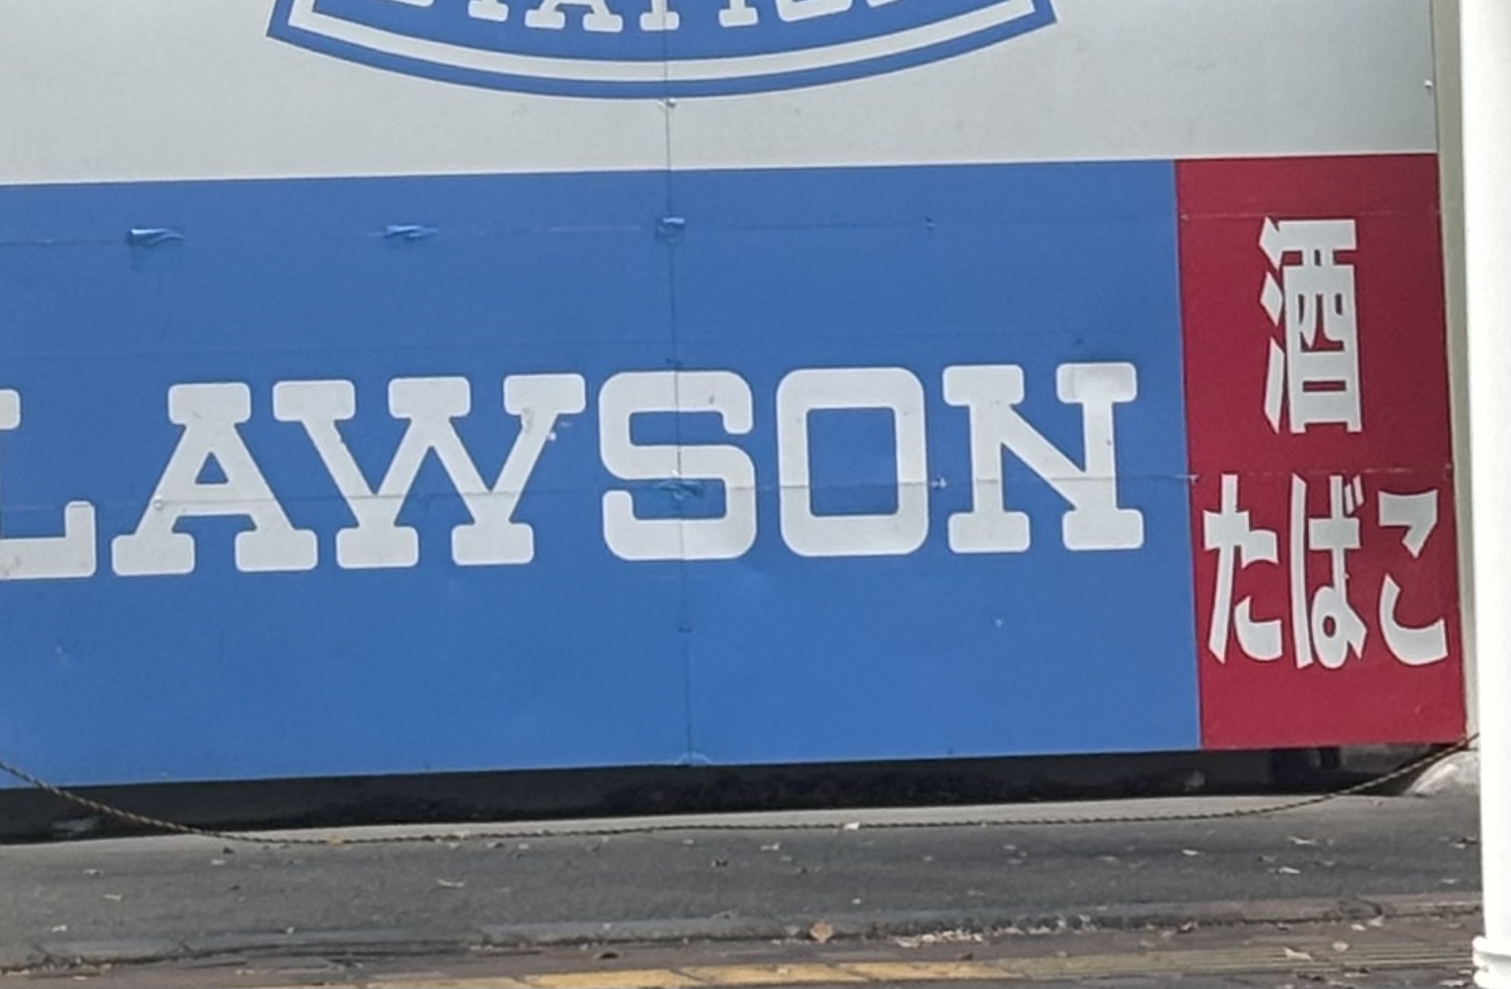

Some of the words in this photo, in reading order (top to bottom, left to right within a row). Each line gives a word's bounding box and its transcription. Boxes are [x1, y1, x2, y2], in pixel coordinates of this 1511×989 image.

[1258, 216, 1364, 435] 酒
[1202, 473, 1449, 670] たばこ
